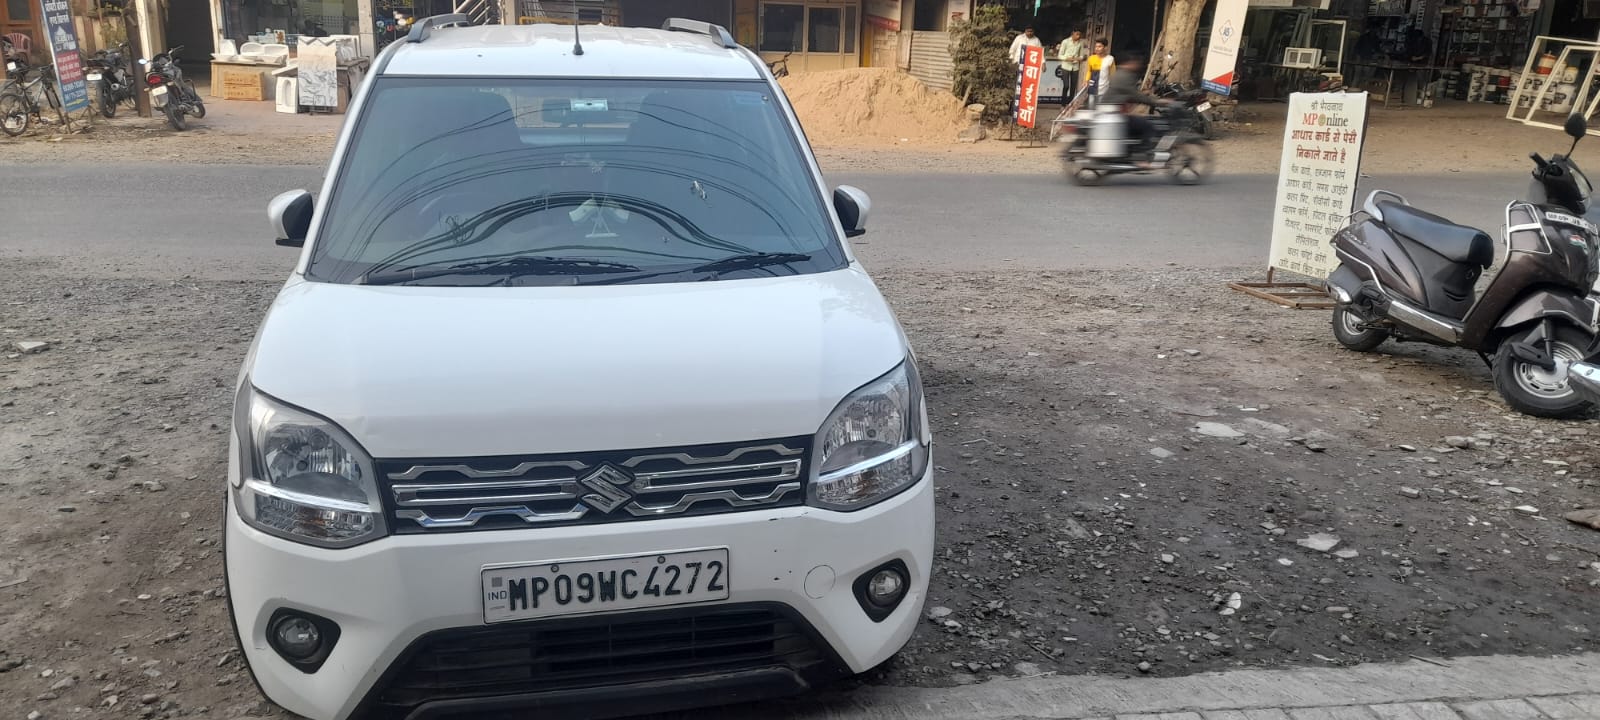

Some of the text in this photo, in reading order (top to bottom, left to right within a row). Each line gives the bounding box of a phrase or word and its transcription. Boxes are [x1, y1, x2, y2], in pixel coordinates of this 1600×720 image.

[1292, 130, 1313, 141] आधार
[1315, 128, 1330, 142] कार्ड
[1333, 128, 1340, 142] से
[1296, 144, 1320, 160] निकाले
[1322, 147, 1338, 162] जाते
[508, 560, 724, 612] MP09WC4272
[488, 590, 507, 600] IND
